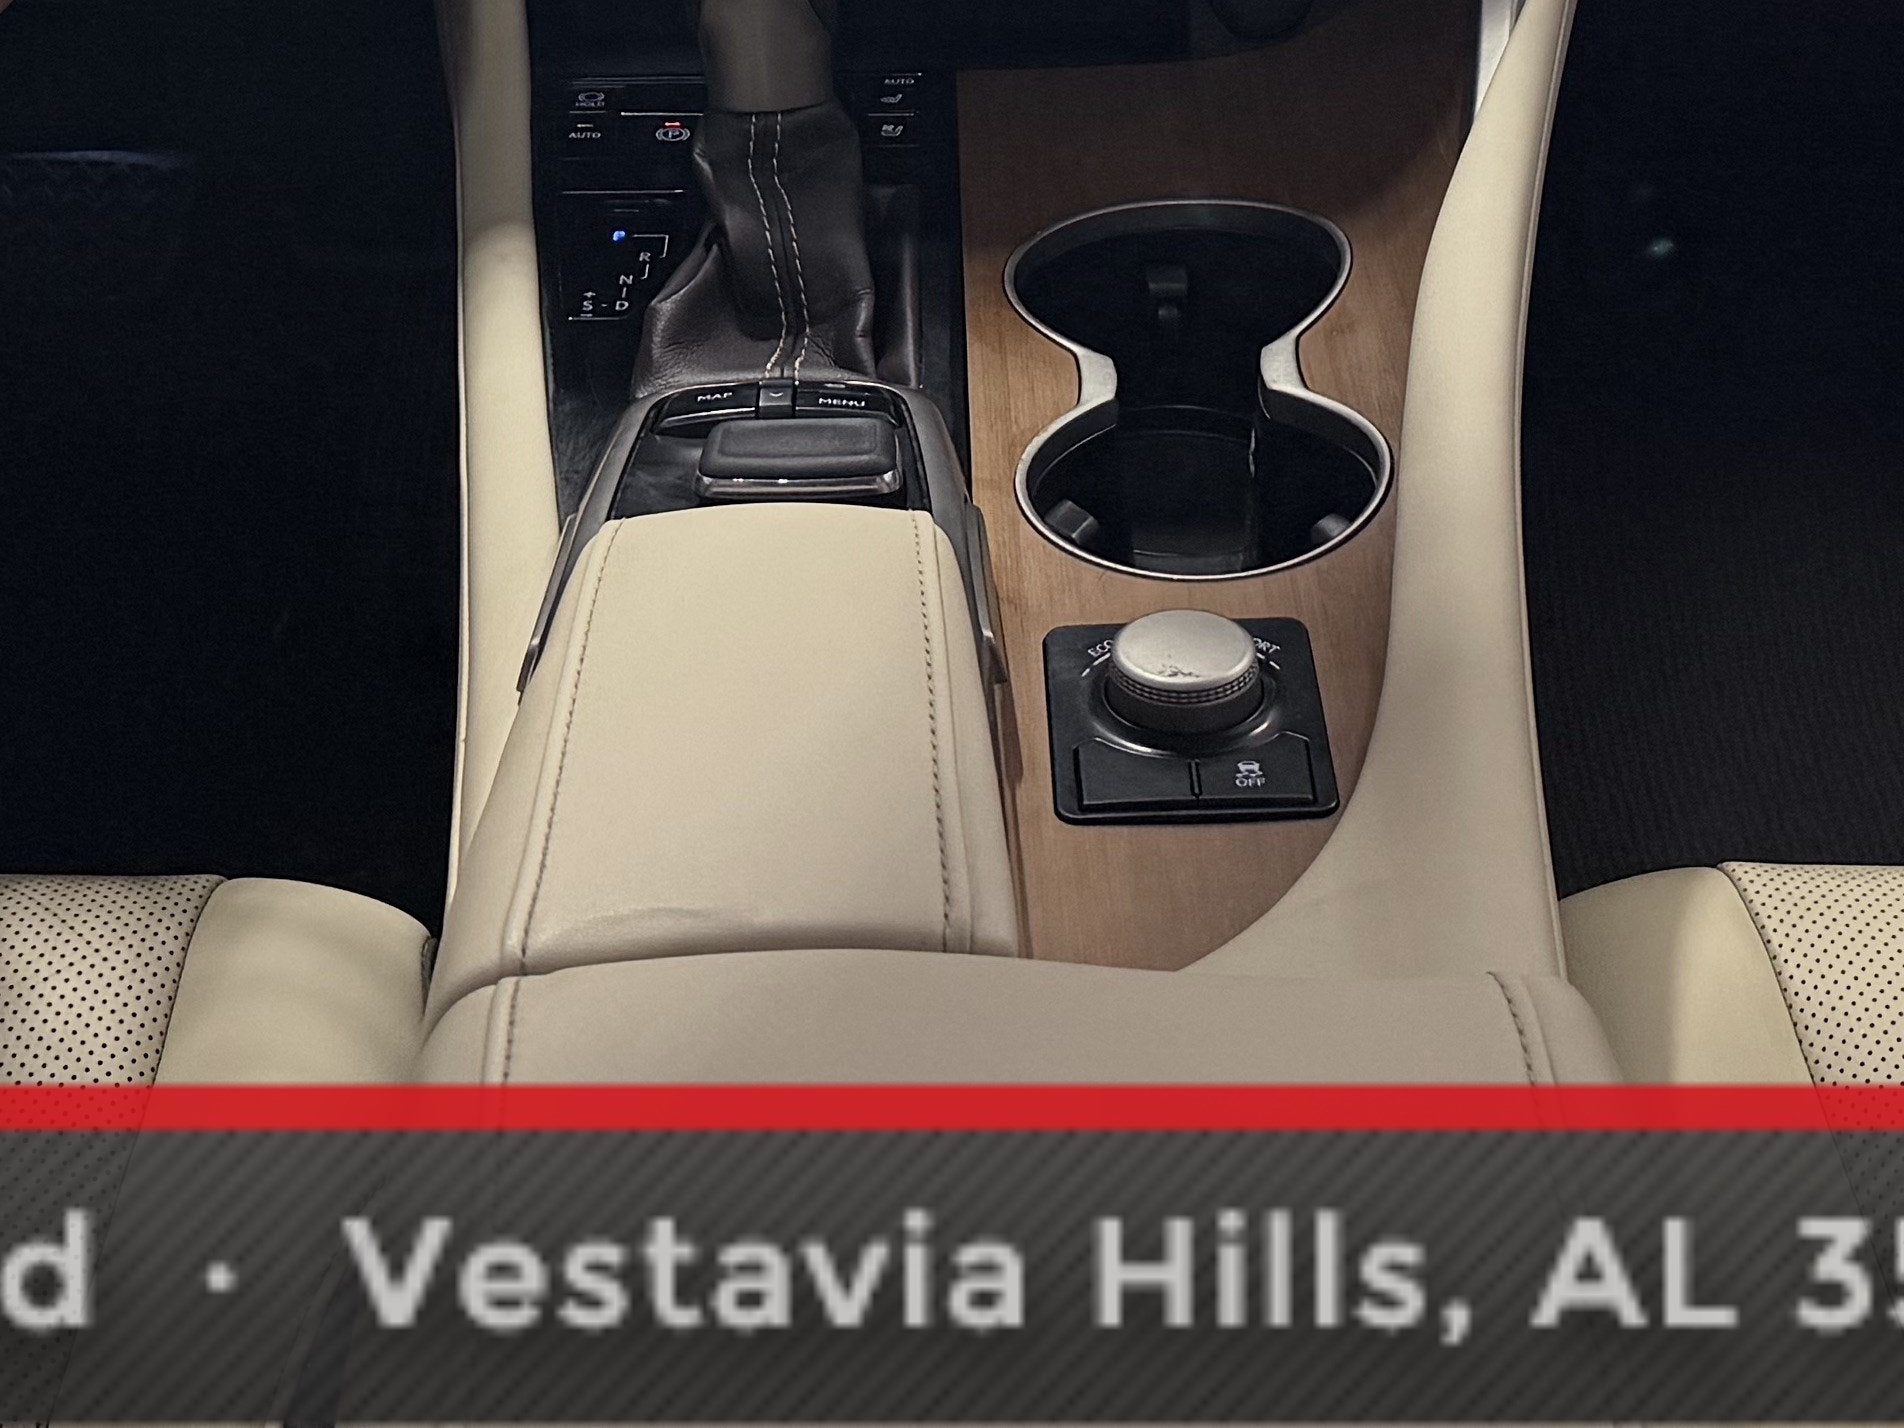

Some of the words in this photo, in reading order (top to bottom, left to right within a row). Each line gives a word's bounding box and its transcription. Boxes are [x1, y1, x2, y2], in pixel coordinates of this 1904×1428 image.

[639, 252, 651, 262] R
[620, 275, 633, 285] N
[583, 300, 593, 311] S
[615, 301, 629, 311] D
[819, 397, 865, 407] MENU
[1235, 778, 1265, 787] OFF
